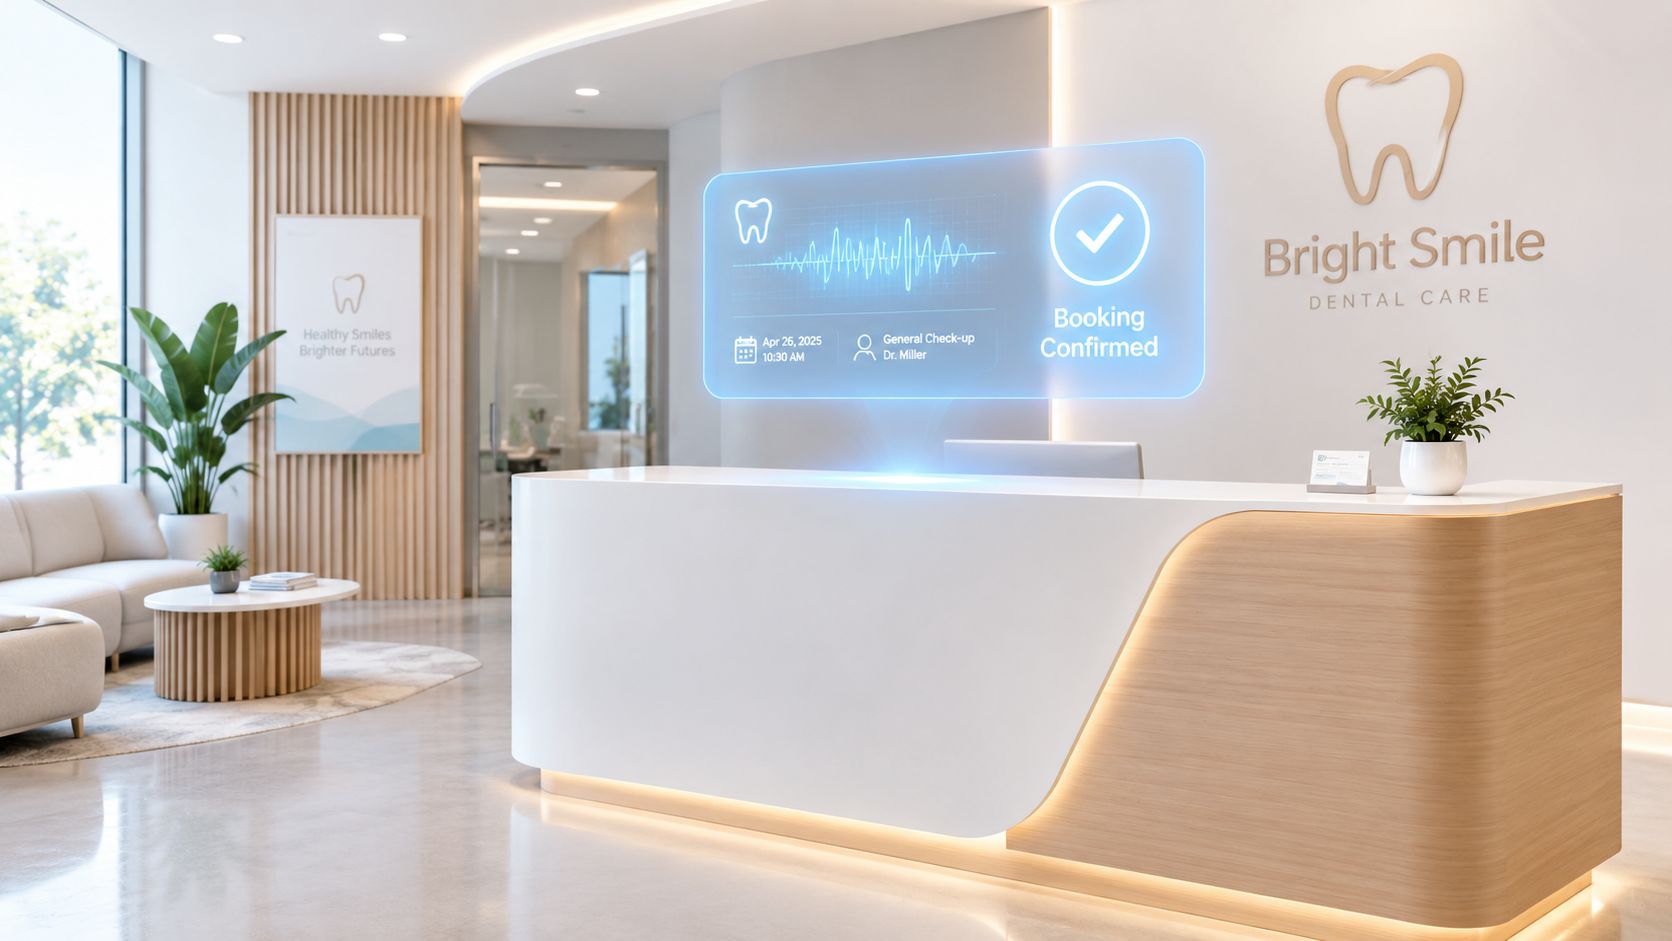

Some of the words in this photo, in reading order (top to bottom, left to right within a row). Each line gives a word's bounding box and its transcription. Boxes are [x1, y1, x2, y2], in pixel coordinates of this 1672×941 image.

[1264, 230, 1397, 285] Bright
[1409, 219, 1545, 268] Smile
[1309, 291, 1405, 310] DENTAL
[1420, 287, 1489, 305] CARE
[1054, 306, 1145, 332] Booking
[303, 328, 349, 343] Healthy
[352, 328, 392, 341] Smiles
[762, 336, 780, 349] Apr
[782, 336, 797, 348] 26,
[798, 335, 822, 346] 2025
[883, 333, 923, 345] General
[925, 333, 975, 346] Check-up
[299, 344, 346, 360] Brighter
[350, 344, 396, 357] Futures
[1040, 335, 1159, 358] Confirmed
[762, 353, 788, 362] 10:30
[789, 352, 805, 362] AM
[883, 350, 897, 361] Dr.
[899, 349, 927, 361] Miller
